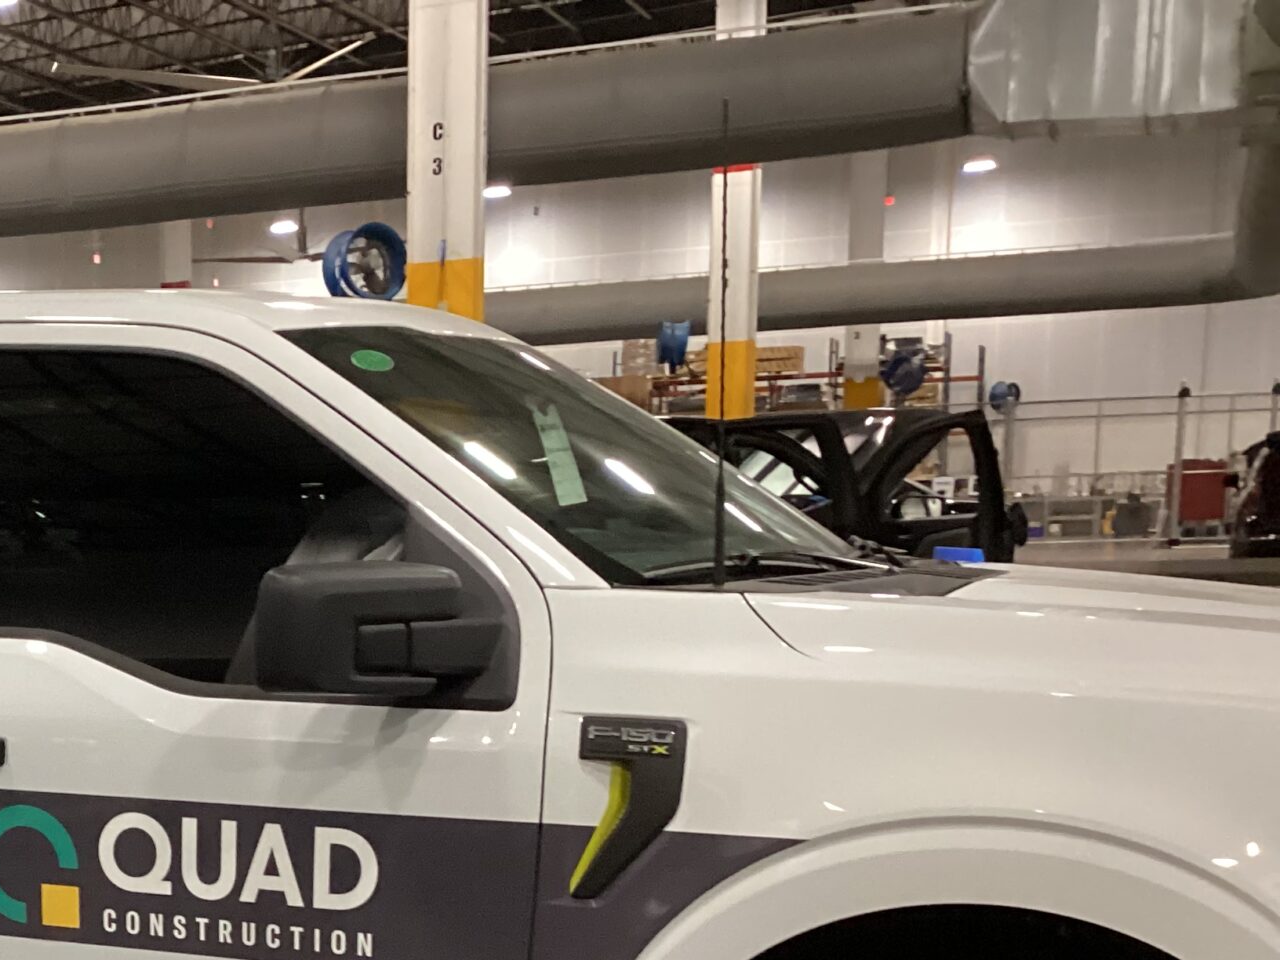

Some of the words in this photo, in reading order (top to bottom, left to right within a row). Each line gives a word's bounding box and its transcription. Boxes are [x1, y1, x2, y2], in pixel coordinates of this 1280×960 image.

[432, 122, 443, 141] C
[432, 157, 442, 176] 3
[98, 811, 379, 911] QUAD
[102, 907, 374, 958] CONSTRUCTION
